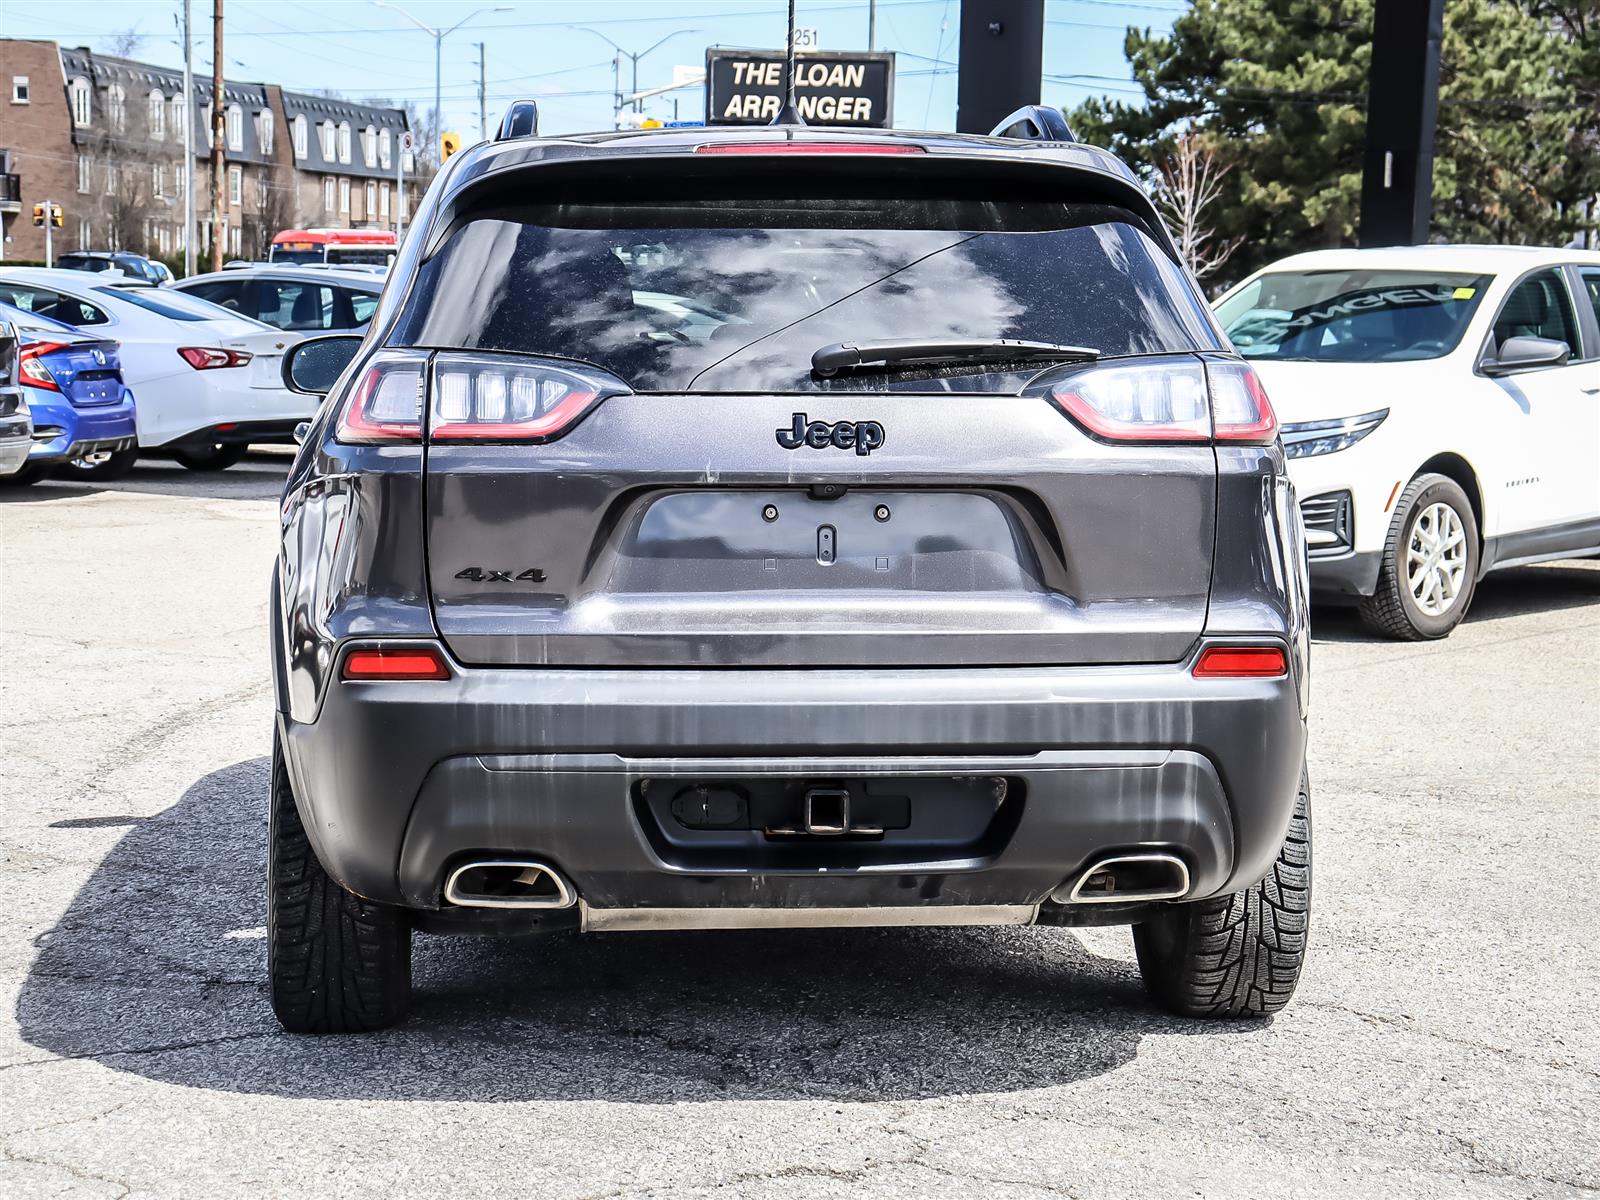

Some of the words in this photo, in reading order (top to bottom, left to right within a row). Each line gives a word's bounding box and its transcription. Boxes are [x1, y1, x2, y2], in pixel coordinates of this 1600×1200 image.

[785, 29, 817, 46] 251
[732, 62, 782, 86] THE
[794, 63, 866, 88] LOAN
[724, 94, 872, 121] ARRNGER
[775, 413, 885, 456] Jeep
[454, 567, 547, 582] 4x4
